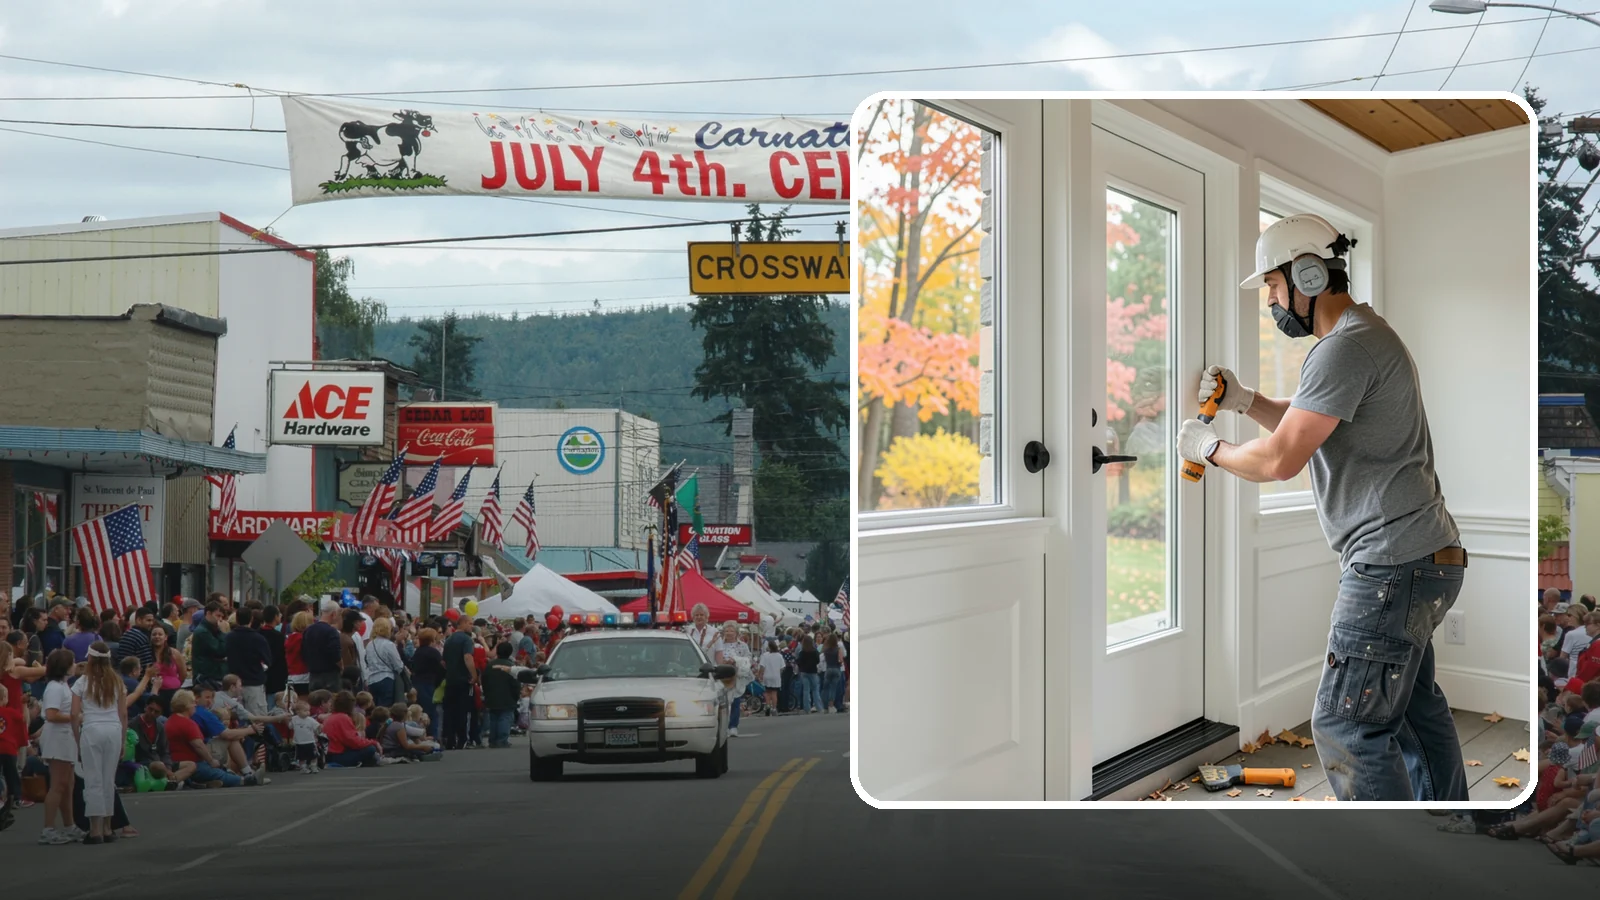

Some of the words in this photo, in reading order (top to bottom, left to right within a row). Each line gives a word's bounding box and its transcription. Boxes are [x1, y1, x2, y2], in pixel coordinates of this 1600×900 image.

[695, 121, 850, 150] Carnat
[481, 141, 605, 192] JULY
[632, 150, 747, 198] 4th.
[697, 254, 850, 280] CROSSWA
[283, 380, 373, 419] ACE
[406, 409, 452, 422] CEDAR
[461, 409, 485, 421] LOG
[284, 421, 370, 436] Hardware
[416, 428, 477, 447] Coca-Cola
[353, 467, 386, 479] Simpl
[95, 485, 124, 495] Vincent
[126, 486, 135, 495] de
[137, 486, 155, 495] Paul
[699, 535, 730, 543] GLASS
